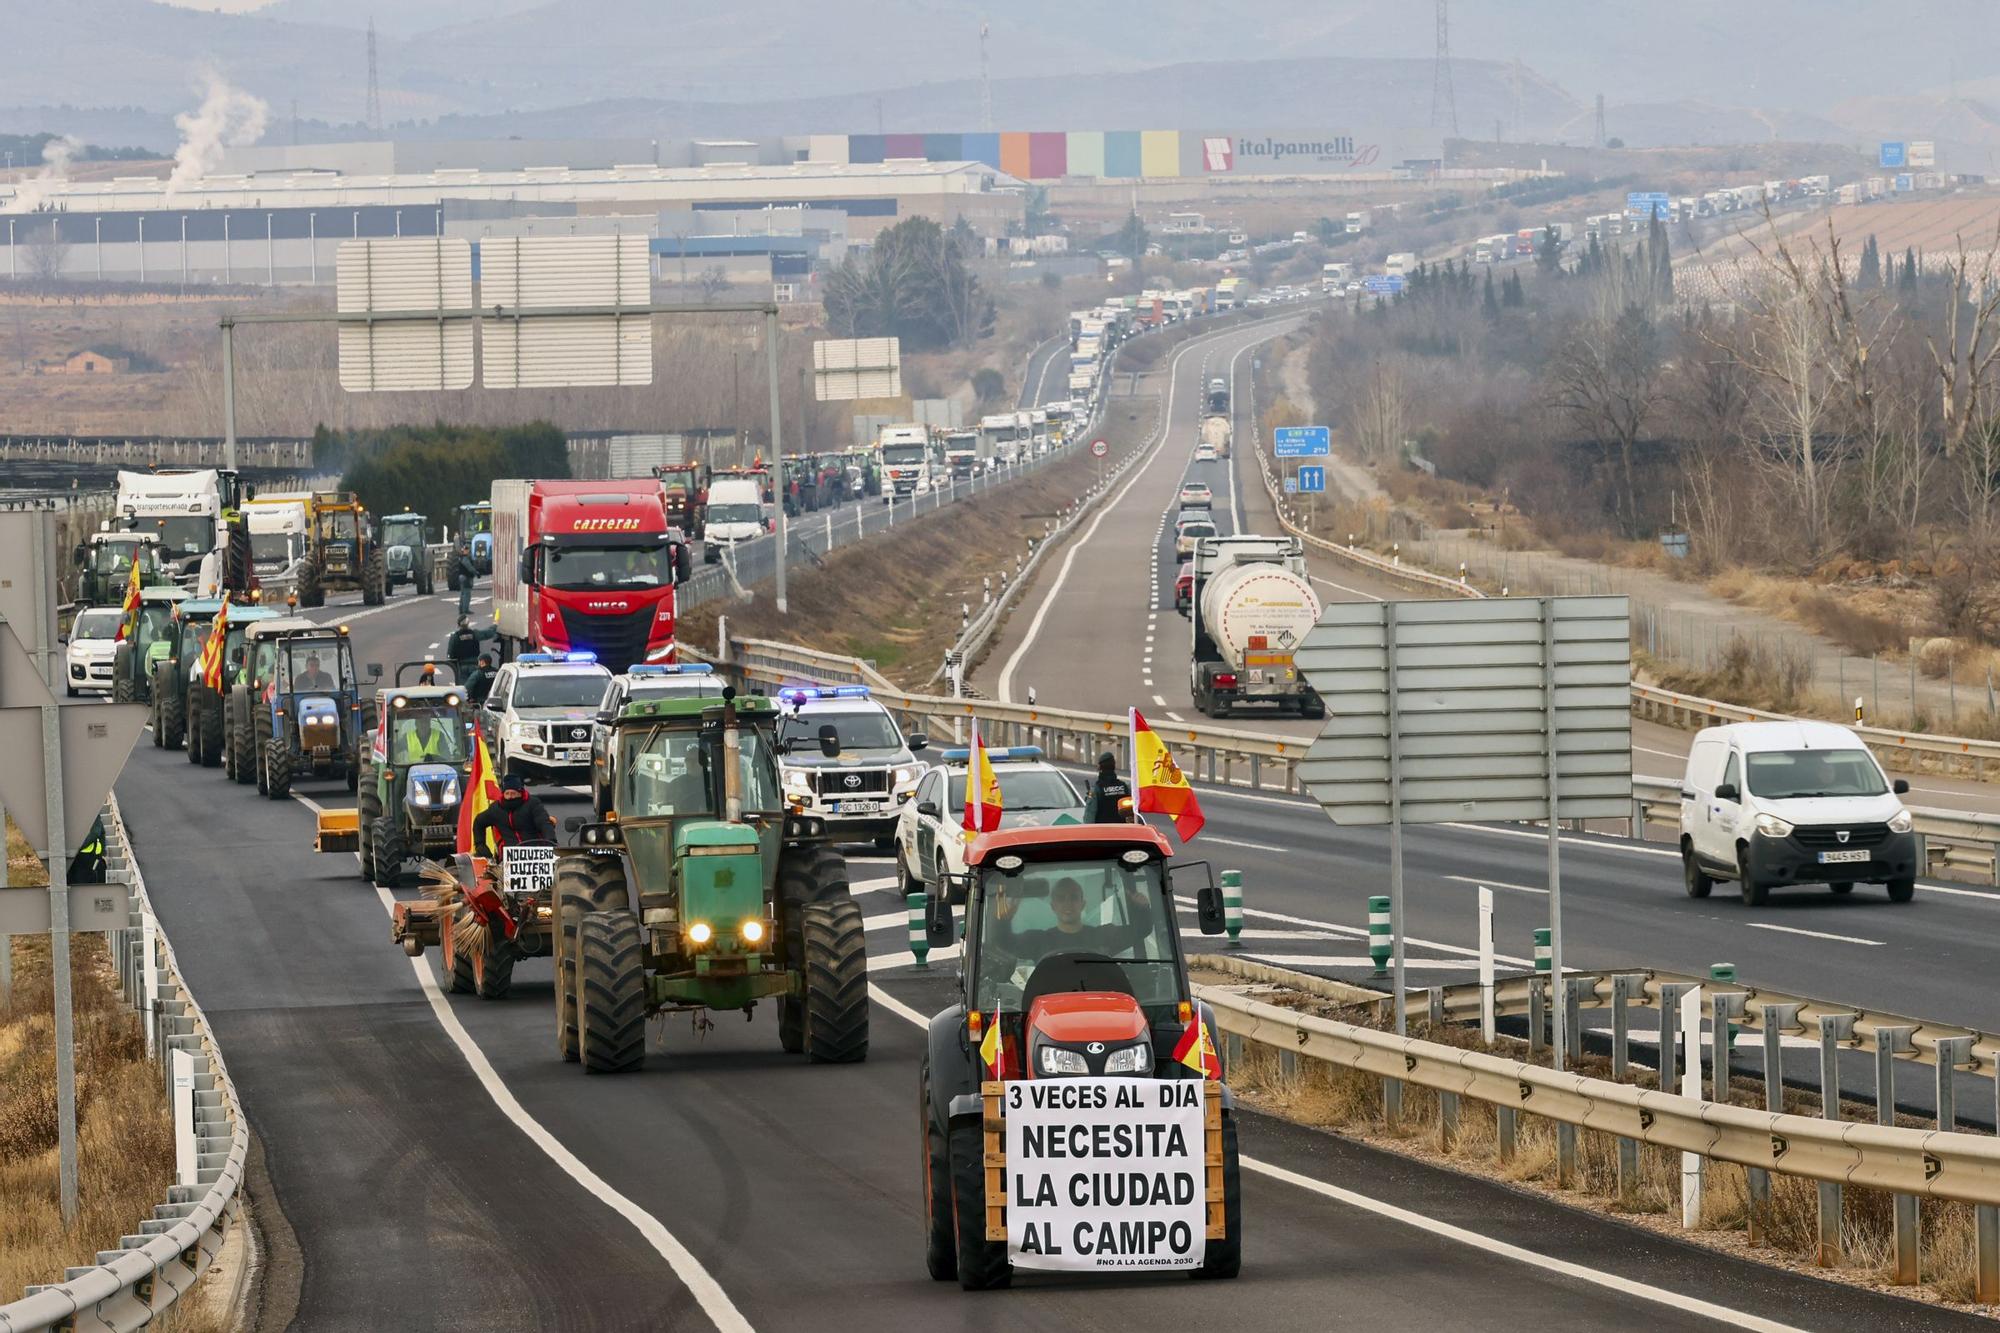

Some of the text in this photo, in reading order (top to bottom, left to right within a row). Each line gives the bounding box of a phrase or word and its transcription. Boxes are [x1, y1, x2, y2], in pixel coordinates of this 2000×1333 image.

[1239, 137, 1353, 160] italpannelli
[573, 518, 640, 530] carreras
[510, 863, 550, 875] QUIERO
[510, 877, 527, 889] MI
[1009, 1080, 1199, 1109] 3 VECES AL DÍA
[1022, 1124, 1188, 1158] NECESITA
[1016, 1172, 1195, 1207] LA CIUDAD
[1019, 1220, 1192, 1255] AL CAMPO
[1174, 1257, 1194, 1265] 2030
